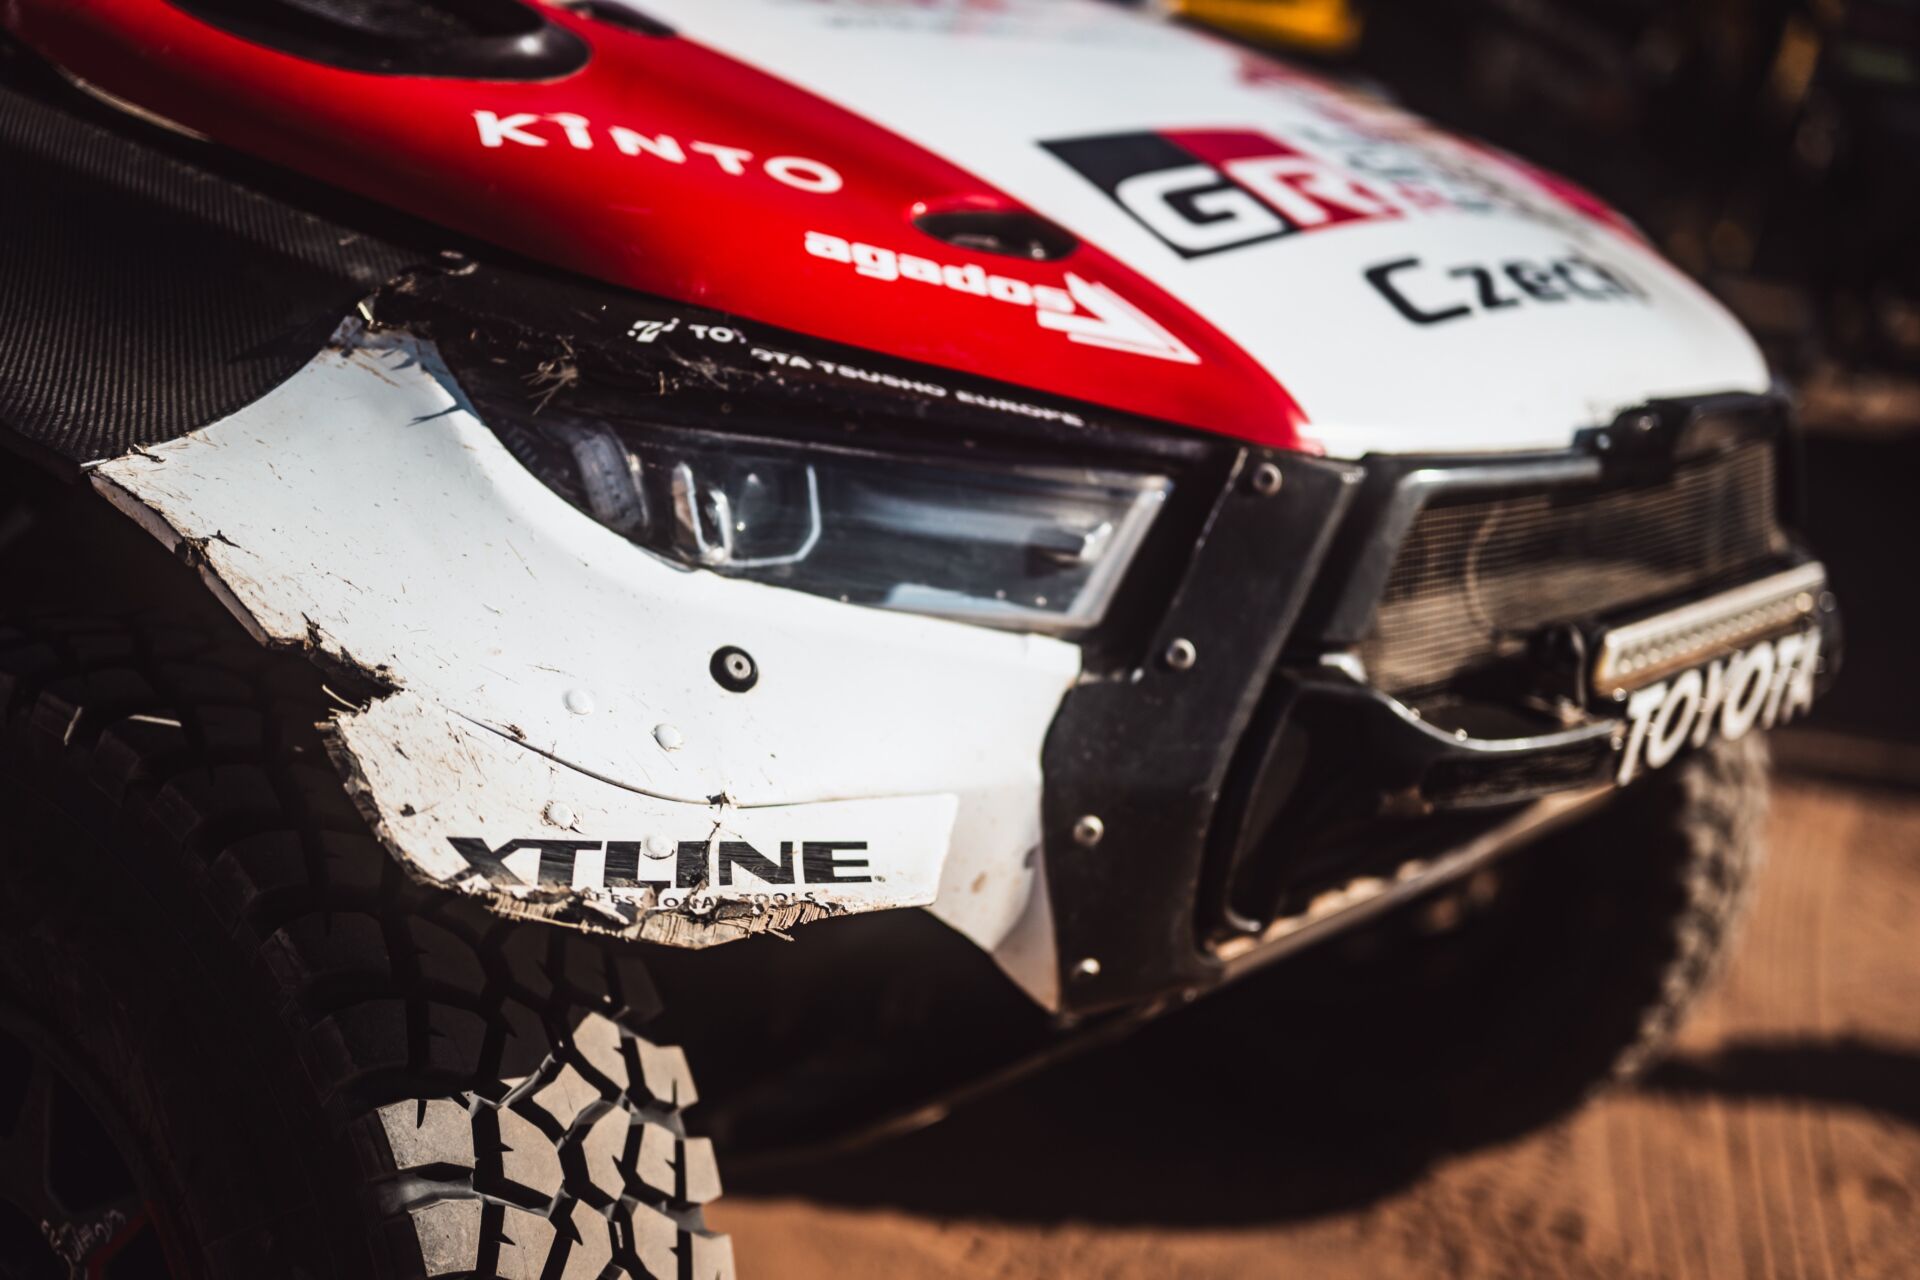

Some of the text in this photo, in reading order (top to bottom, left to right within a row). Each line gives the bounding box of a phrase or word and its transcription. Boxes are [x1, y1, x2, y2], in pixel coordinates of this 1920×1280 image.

[473, 109, 844, 194] KINTO
[804, 231, 1076, 314] agados
[1616, 624, 1822, 788] TOYOTA
[440, 836, 873, 890] XTLINE
